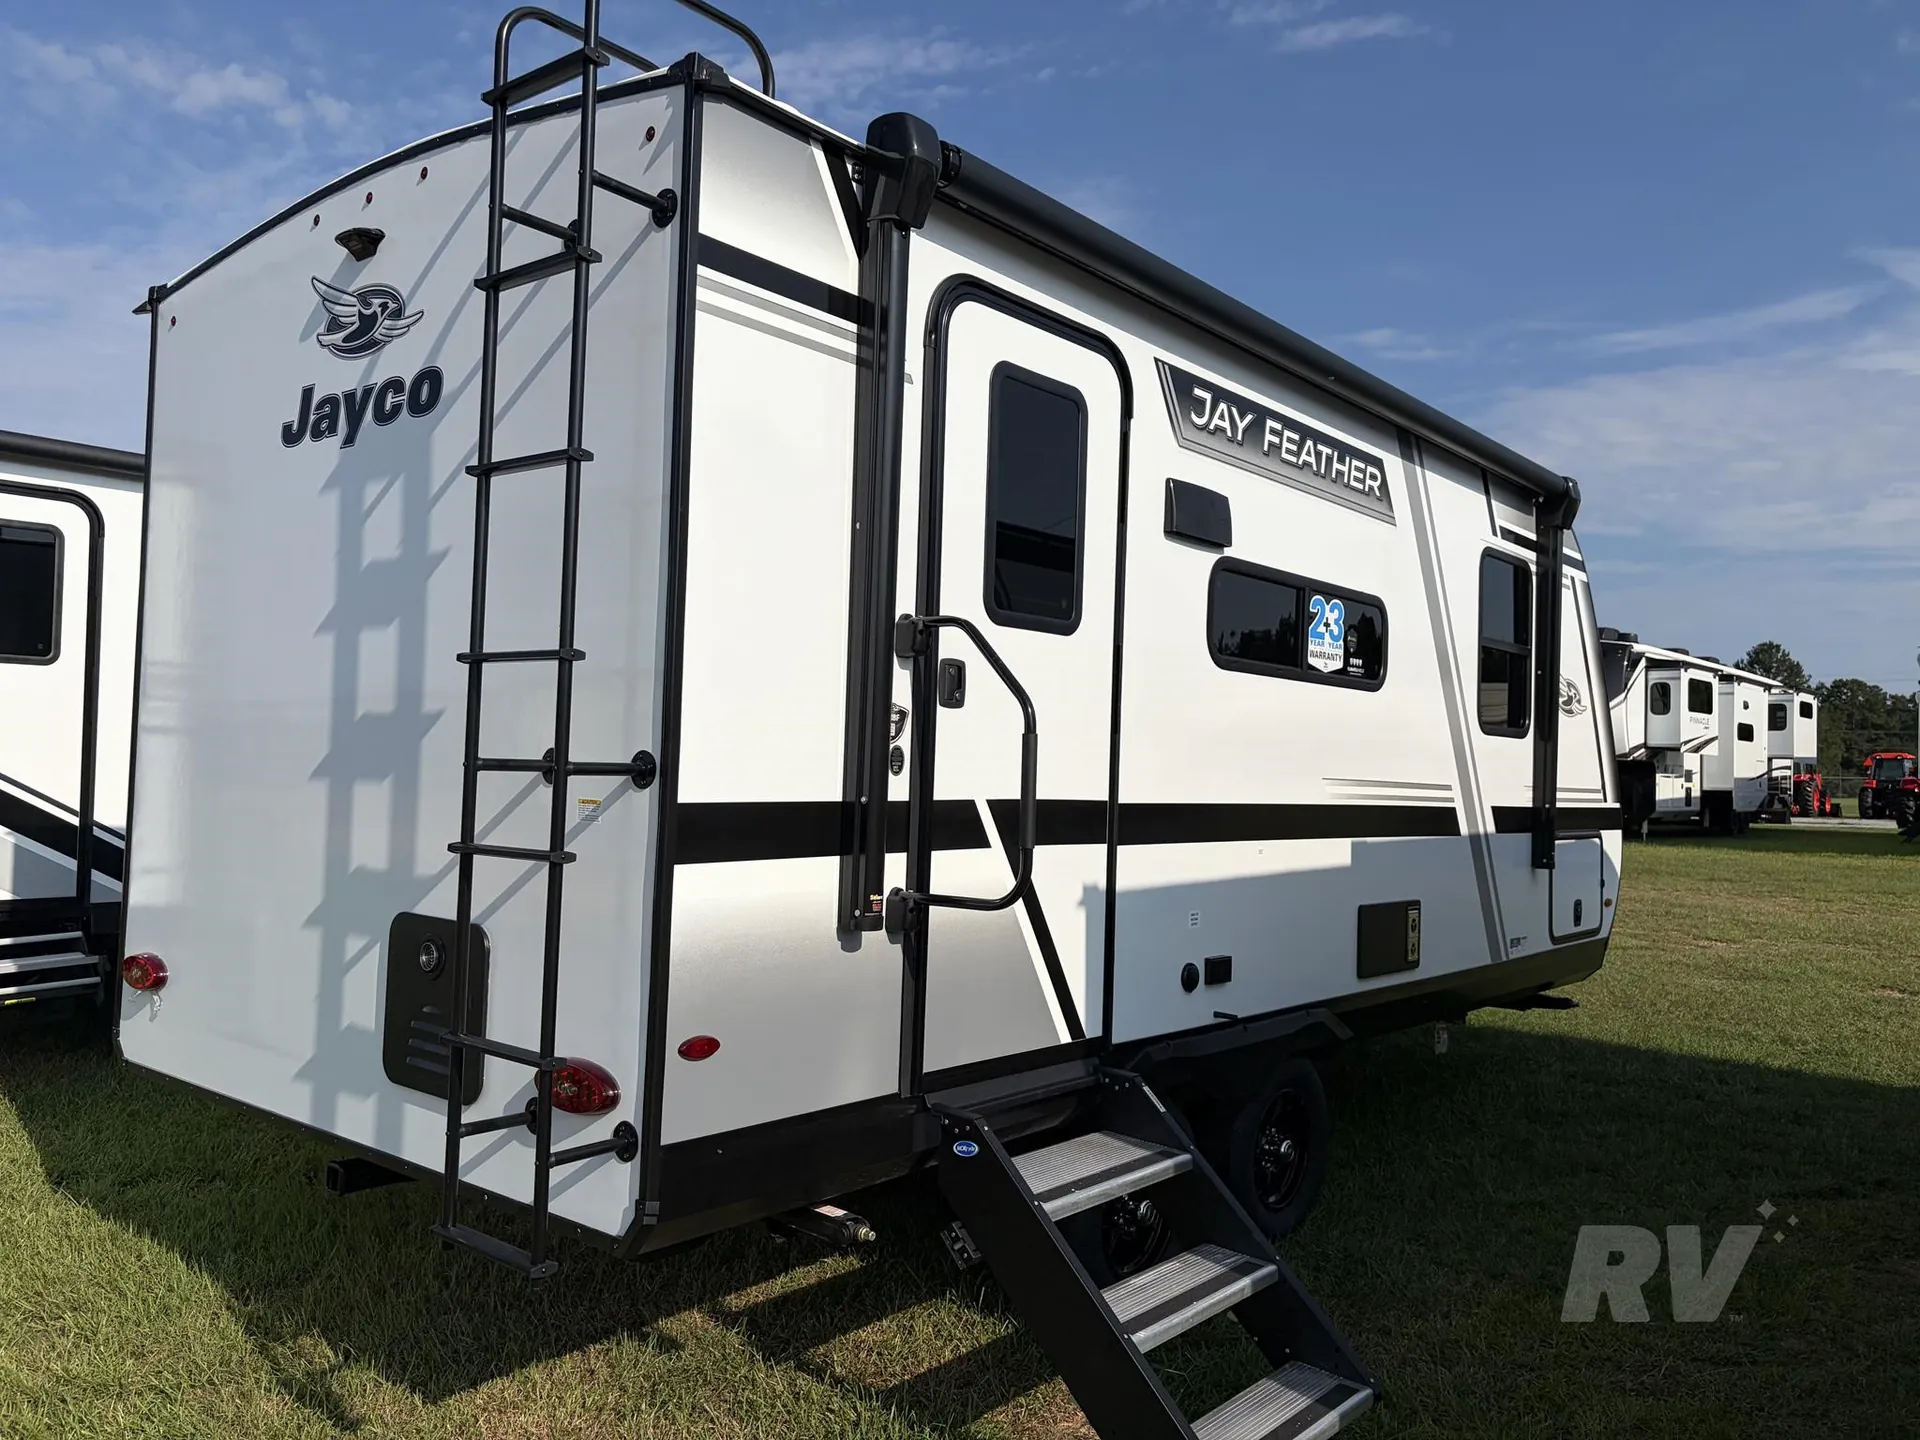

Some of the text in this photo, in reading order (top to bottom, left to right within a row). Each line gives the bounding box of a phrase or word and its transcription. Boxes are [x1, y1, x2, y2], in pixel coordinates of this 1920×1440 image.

[281, 366, 445, 449] Jayco
[1190, 385, 1383, 501] JAY FEATHER
[1309, 649, 1343, 663] WARRANTY
[1310, 639, 1325, 648] YEAR
[1328, 641, 1343, 651] YEAR
